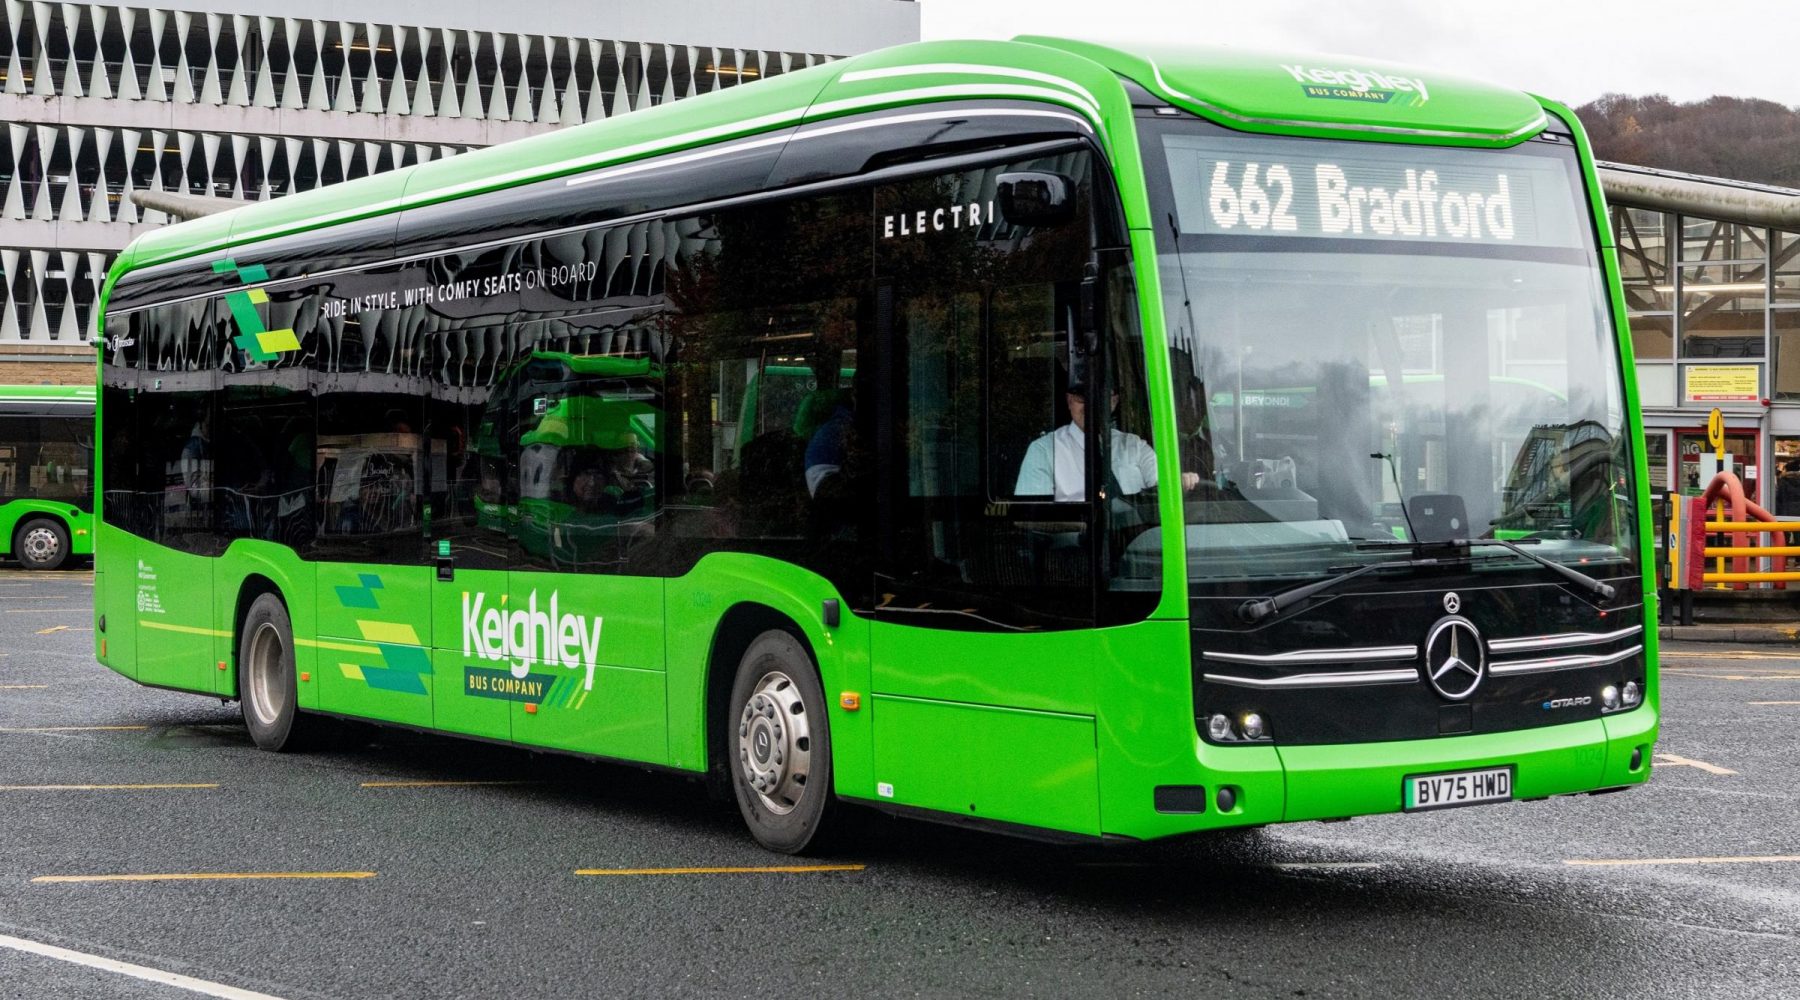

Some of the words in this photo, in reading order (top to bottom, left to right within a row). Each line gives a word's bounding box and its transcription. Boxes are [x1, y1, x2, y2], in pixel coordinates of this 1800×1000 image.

[1279, 63, 1430, 101] Keighley
[1309, 87, 1330, 96] BUS
[1333, 89, 1385, 100] COMPANY
[1209, 160, 1298, 231] 662
[1315, 163, 1515, 240] Bradford
[884, 200, 994, 239] ELECTRI
[324, 299, 347, 319] RIDE
[350, 297, 361, 315] IN
[365, 291, 400, 312] STYLE,
[404, 286, 434, 307] WITH
[438, 278, 480, 302] COMFY
[483, 272, 521, 296] SEATS
[526, 268, 545, 290] ON
[551, 261, 596, 287] BOARD
[1712, 415, 1720, 440] J
[462, 587, 604, 691] Keighley
[469, 674, 488, 690] BUS
[491, 678, 543, 697] COMPANY
[1418, 776, 1467, 804] BV75
[1472, 772, 1508, 798] HWD
